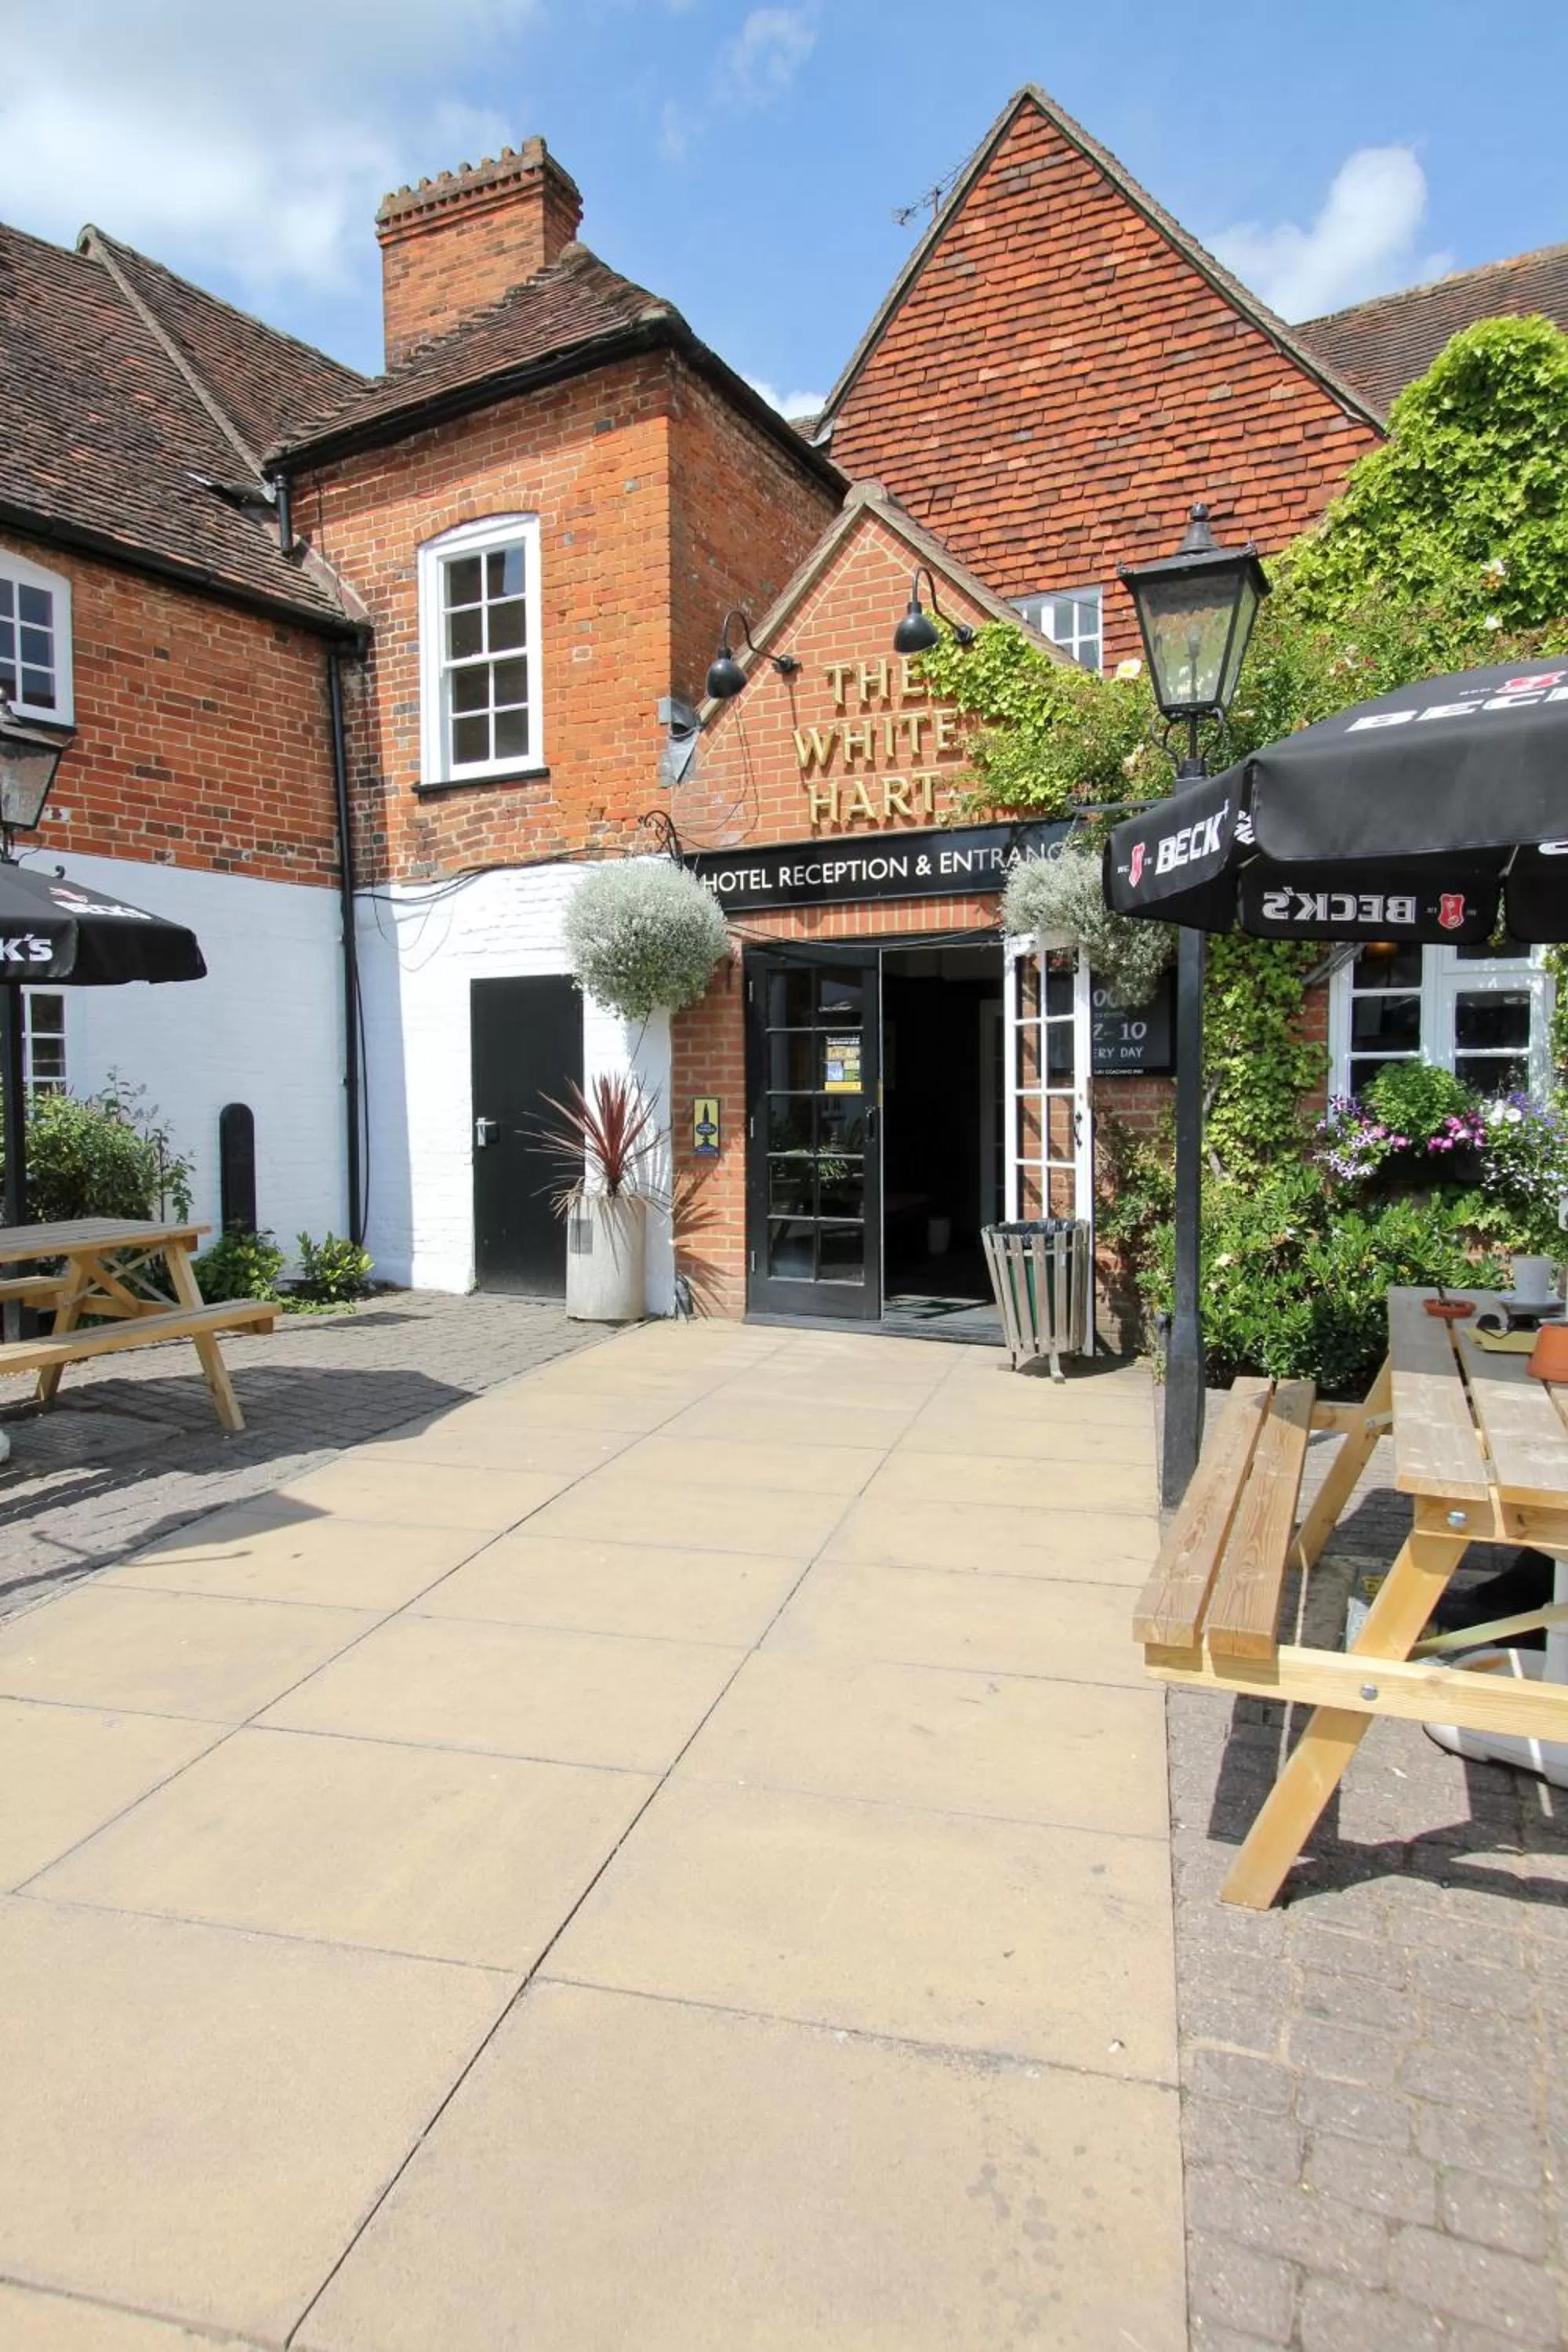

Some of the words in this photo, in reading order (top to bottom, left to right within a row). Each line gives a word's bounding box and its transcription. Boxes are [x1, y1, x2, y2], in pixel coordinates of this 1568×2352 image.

[823, 655, 925, 704] THE
[791, 708, 959, 768] WHITE
[805, 771, 941, 824] HART
[703, 869, 771, 892] HOTEL
[779, 856, 907, 887] RECEPTION
[915, 855, 931, 876] &
[940, 841, 1065, 874] ENTRANC
[0, 934, 53, 962] K'S
[1119, 1022, 1147, 1040] 10
[1120, 1046, 1145, 1058] DAY
